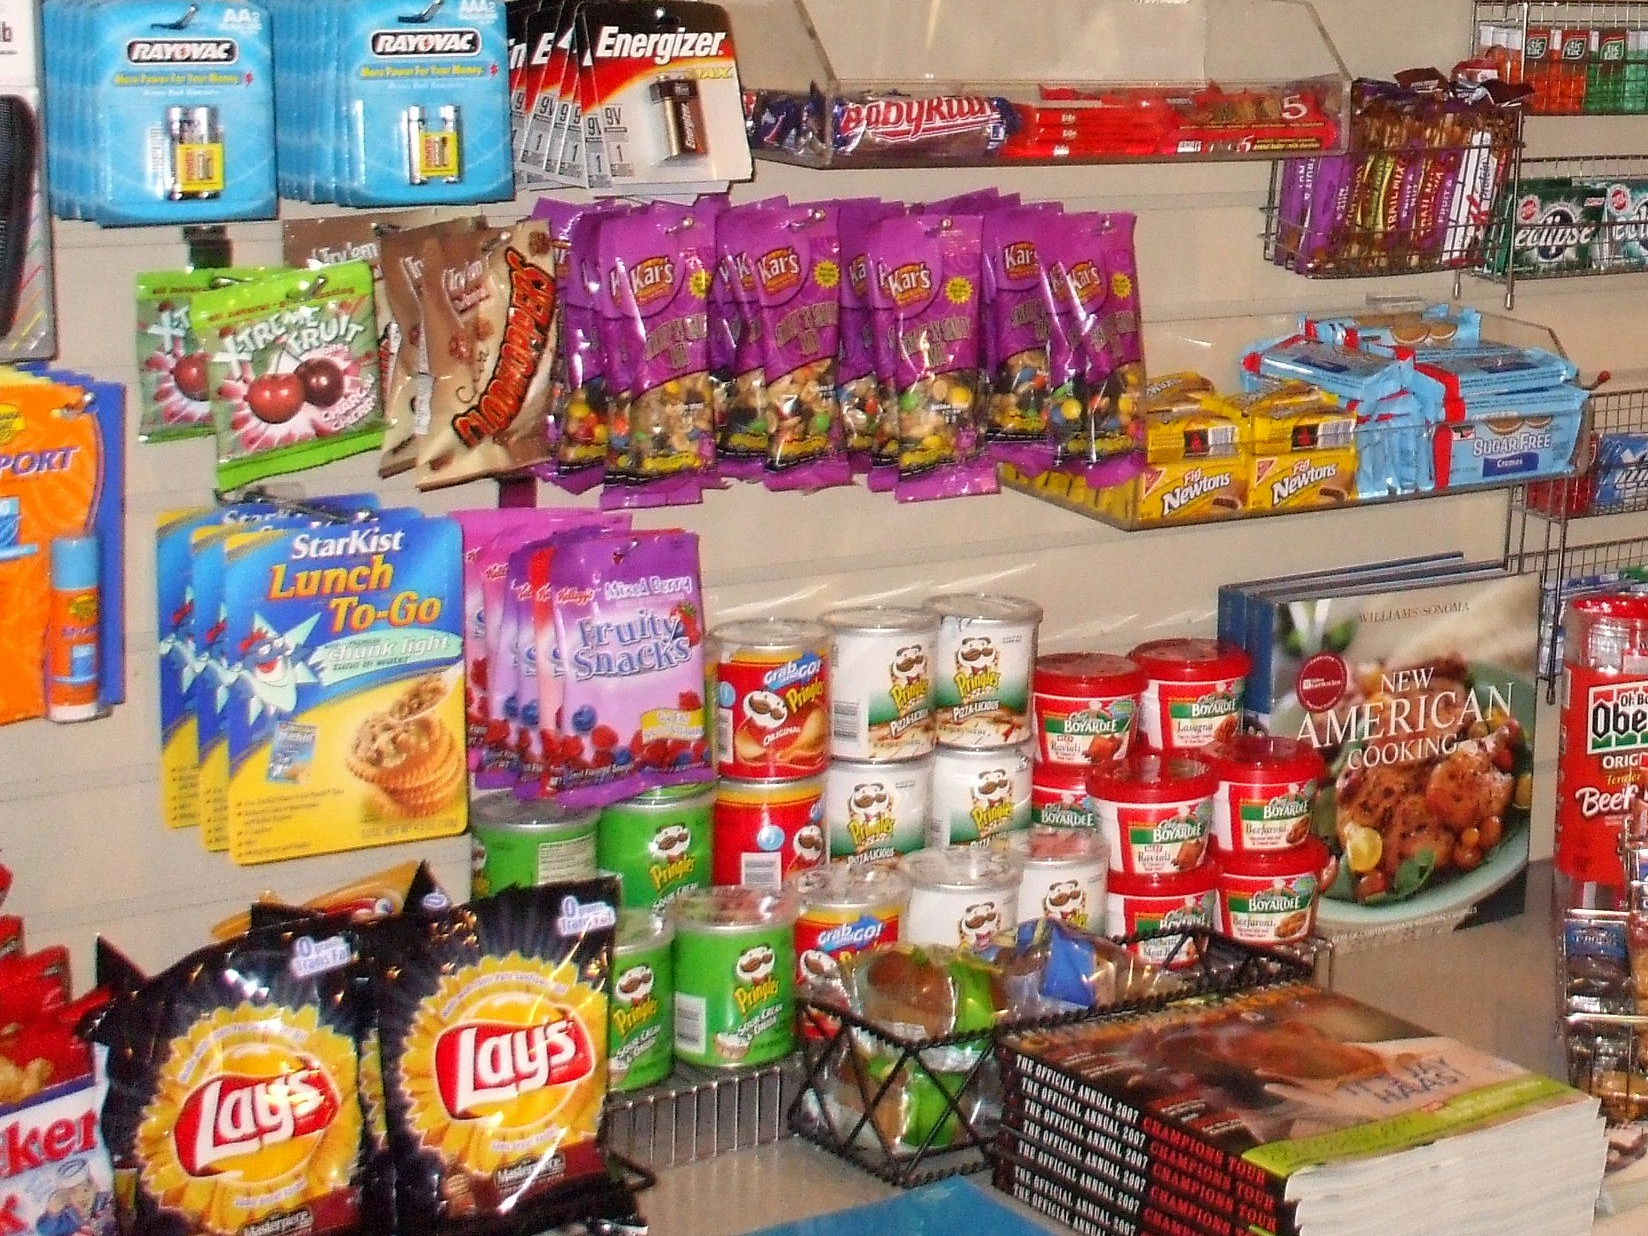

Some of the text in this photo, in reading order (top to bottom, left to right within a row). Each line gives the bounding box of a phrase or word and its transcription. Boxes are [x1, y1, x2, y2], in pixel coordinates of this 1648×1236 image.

[132, 43, 231, 61] RAYOVAC
[376, 34, 474, 54] RAYOVAC
[596, 26, 727, 65] Energizer
[630, 258, 673, 290] Kar's
[756, 252, 799, 284] Kar's
[888, 264, 931, 292] Kar's
[288, 315, 365, 356] FRUIT
[1473, 433, 1551, 456] SUGAR FREE
[1184, 467, 1202, 486] Fig
[1272, 461, 1337, 506] Newtons
[1161, 471, 1231, 516] Newtons
[292, 527, 405, 560] StarKist
[269, 555, 394, 600] Lunch
[330, 591, 442, 633] To-Go
[578, 610, 681, 648] Fruity
[401, 636, 449, 656] light
[574, 637, 692, 681] Snacks
[954, 670, 1001, 699] Pringles
[1381, 667, 1434, 694] NEW
[1191, 698, 1236, 717] BOYARDEE
[1297, 682, 1514, 749] AMERICAN
[1064, 718, 1118, 733] BOYARDEE
[1348, 734, 1458, 770] COOKING
[1576, 785, 1638, 816] Beef
[650, 854, 695, 890] Pringles
[1249, 898, 1300, 912] BOYARDEE
[733, 977, 779, 1014] Pringles
[1017, 1054, 1034, 1072] THE
[1036, 1059, 1075, 1093] OFFICIAL
[1077, 1083, 1113, 1114] ANNUAL
[1116, 1101, 1140, 1125] 2007
[1143, 1117, 1224, 1164] CHAMPIONS
[1041, 1083, 1147, 1147] OFFICIAL ANNUAL 2007
